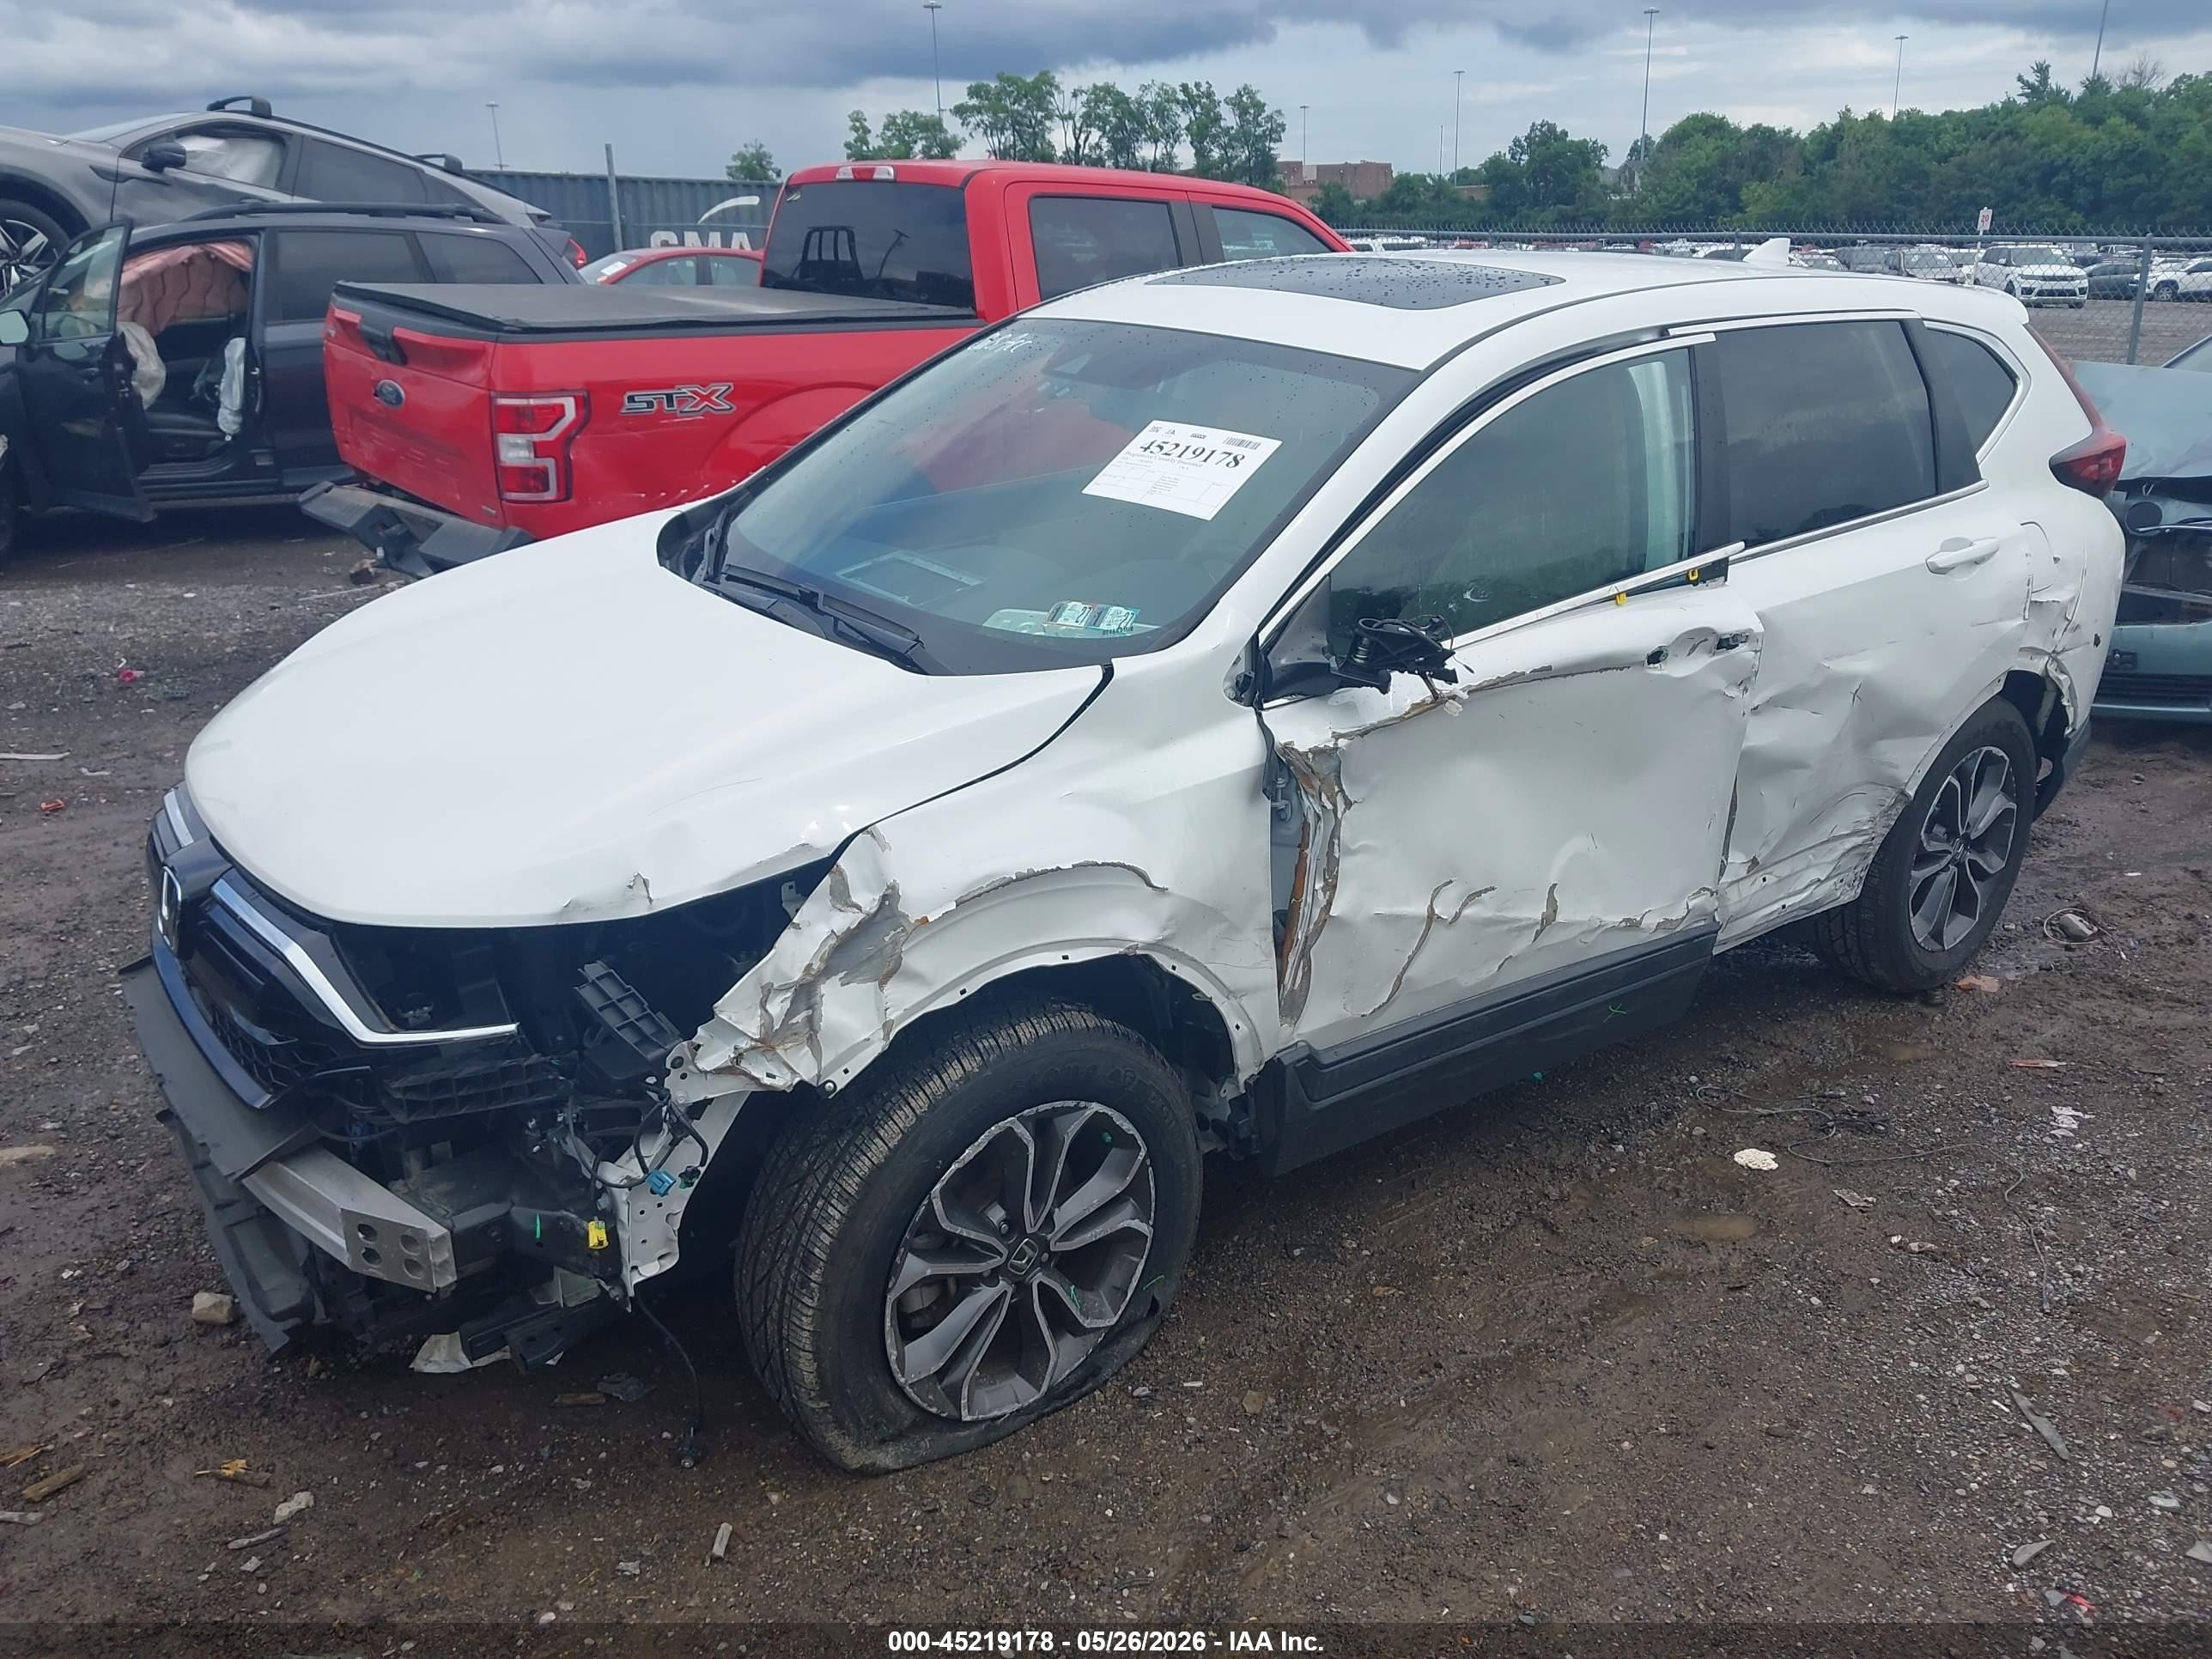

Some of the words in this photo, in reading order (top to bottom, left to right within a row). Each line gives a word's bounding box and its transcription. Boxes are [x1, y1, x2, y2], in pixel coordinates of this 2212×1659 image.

[619, 382, 736, 416] STX
[1139, 439, 1246, 469] 45219178
[1075, 606, 1093, 625] 27
[1117, 611, 1135, 628] 27
